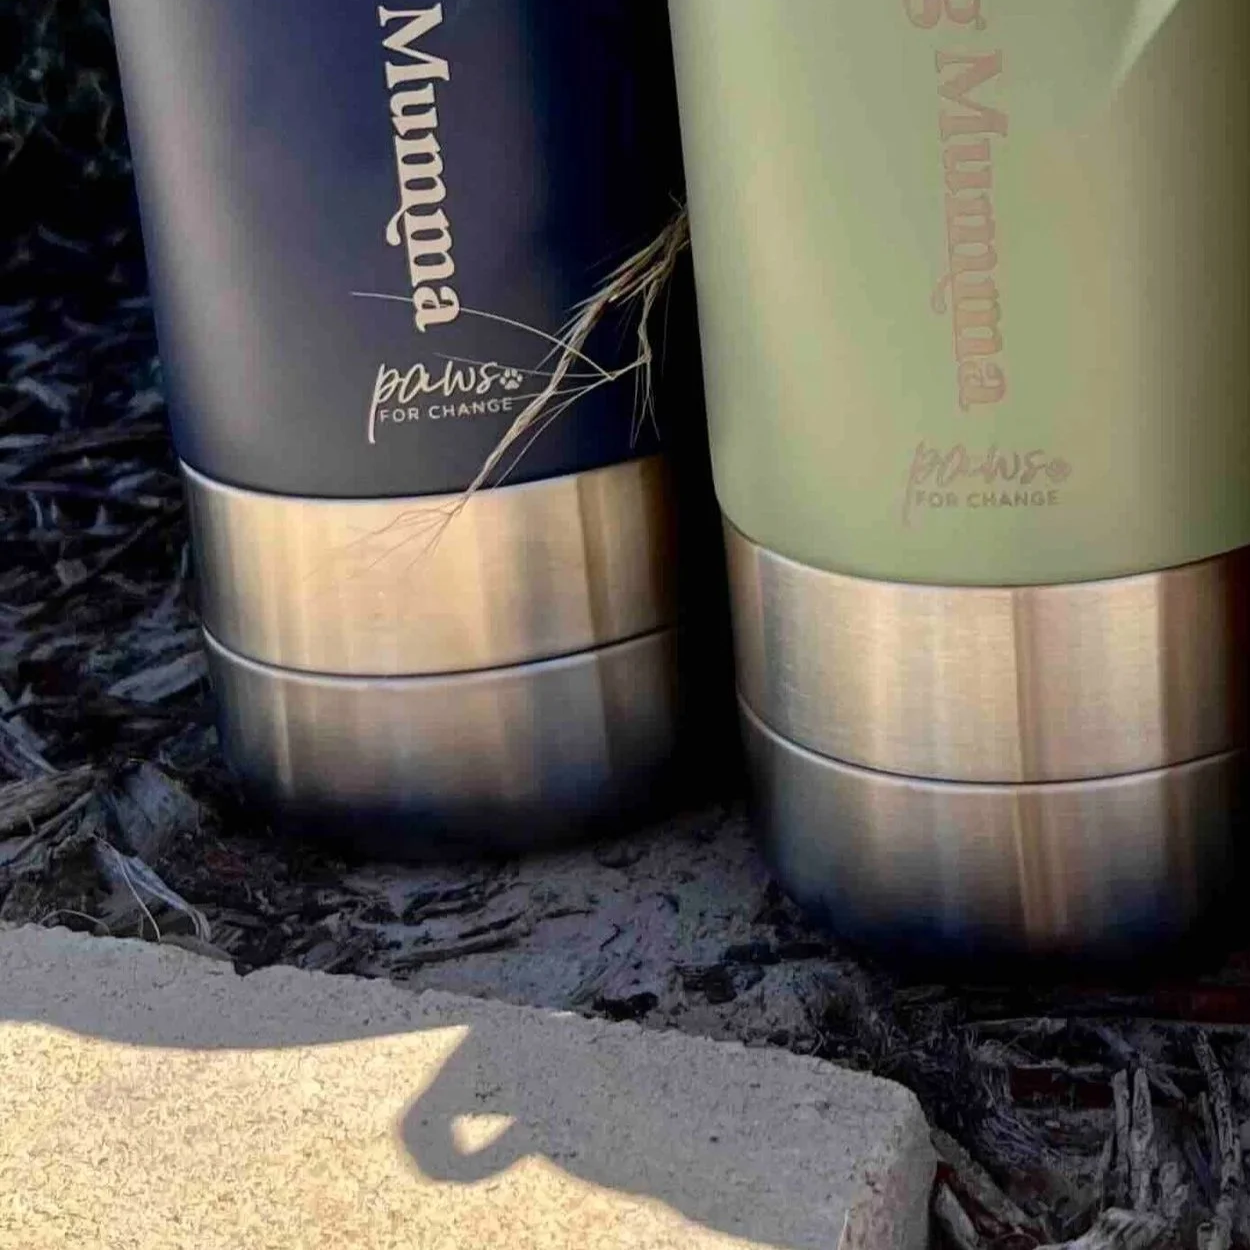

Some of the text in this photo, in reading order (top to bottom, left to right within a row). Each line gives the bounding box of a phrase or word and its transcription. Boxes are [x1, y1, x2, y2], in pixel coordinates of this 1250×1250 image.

[378, 2, 463, 332] Mumma
[929, 49, 1009, 413] Mumma
[368, 361, 500, 444] paws
[379, 397, 513, 423] FOR CHANGE
[902, 439, 1047, 528] paws
[915, 489, 1061, 508] FOR CHANGE
